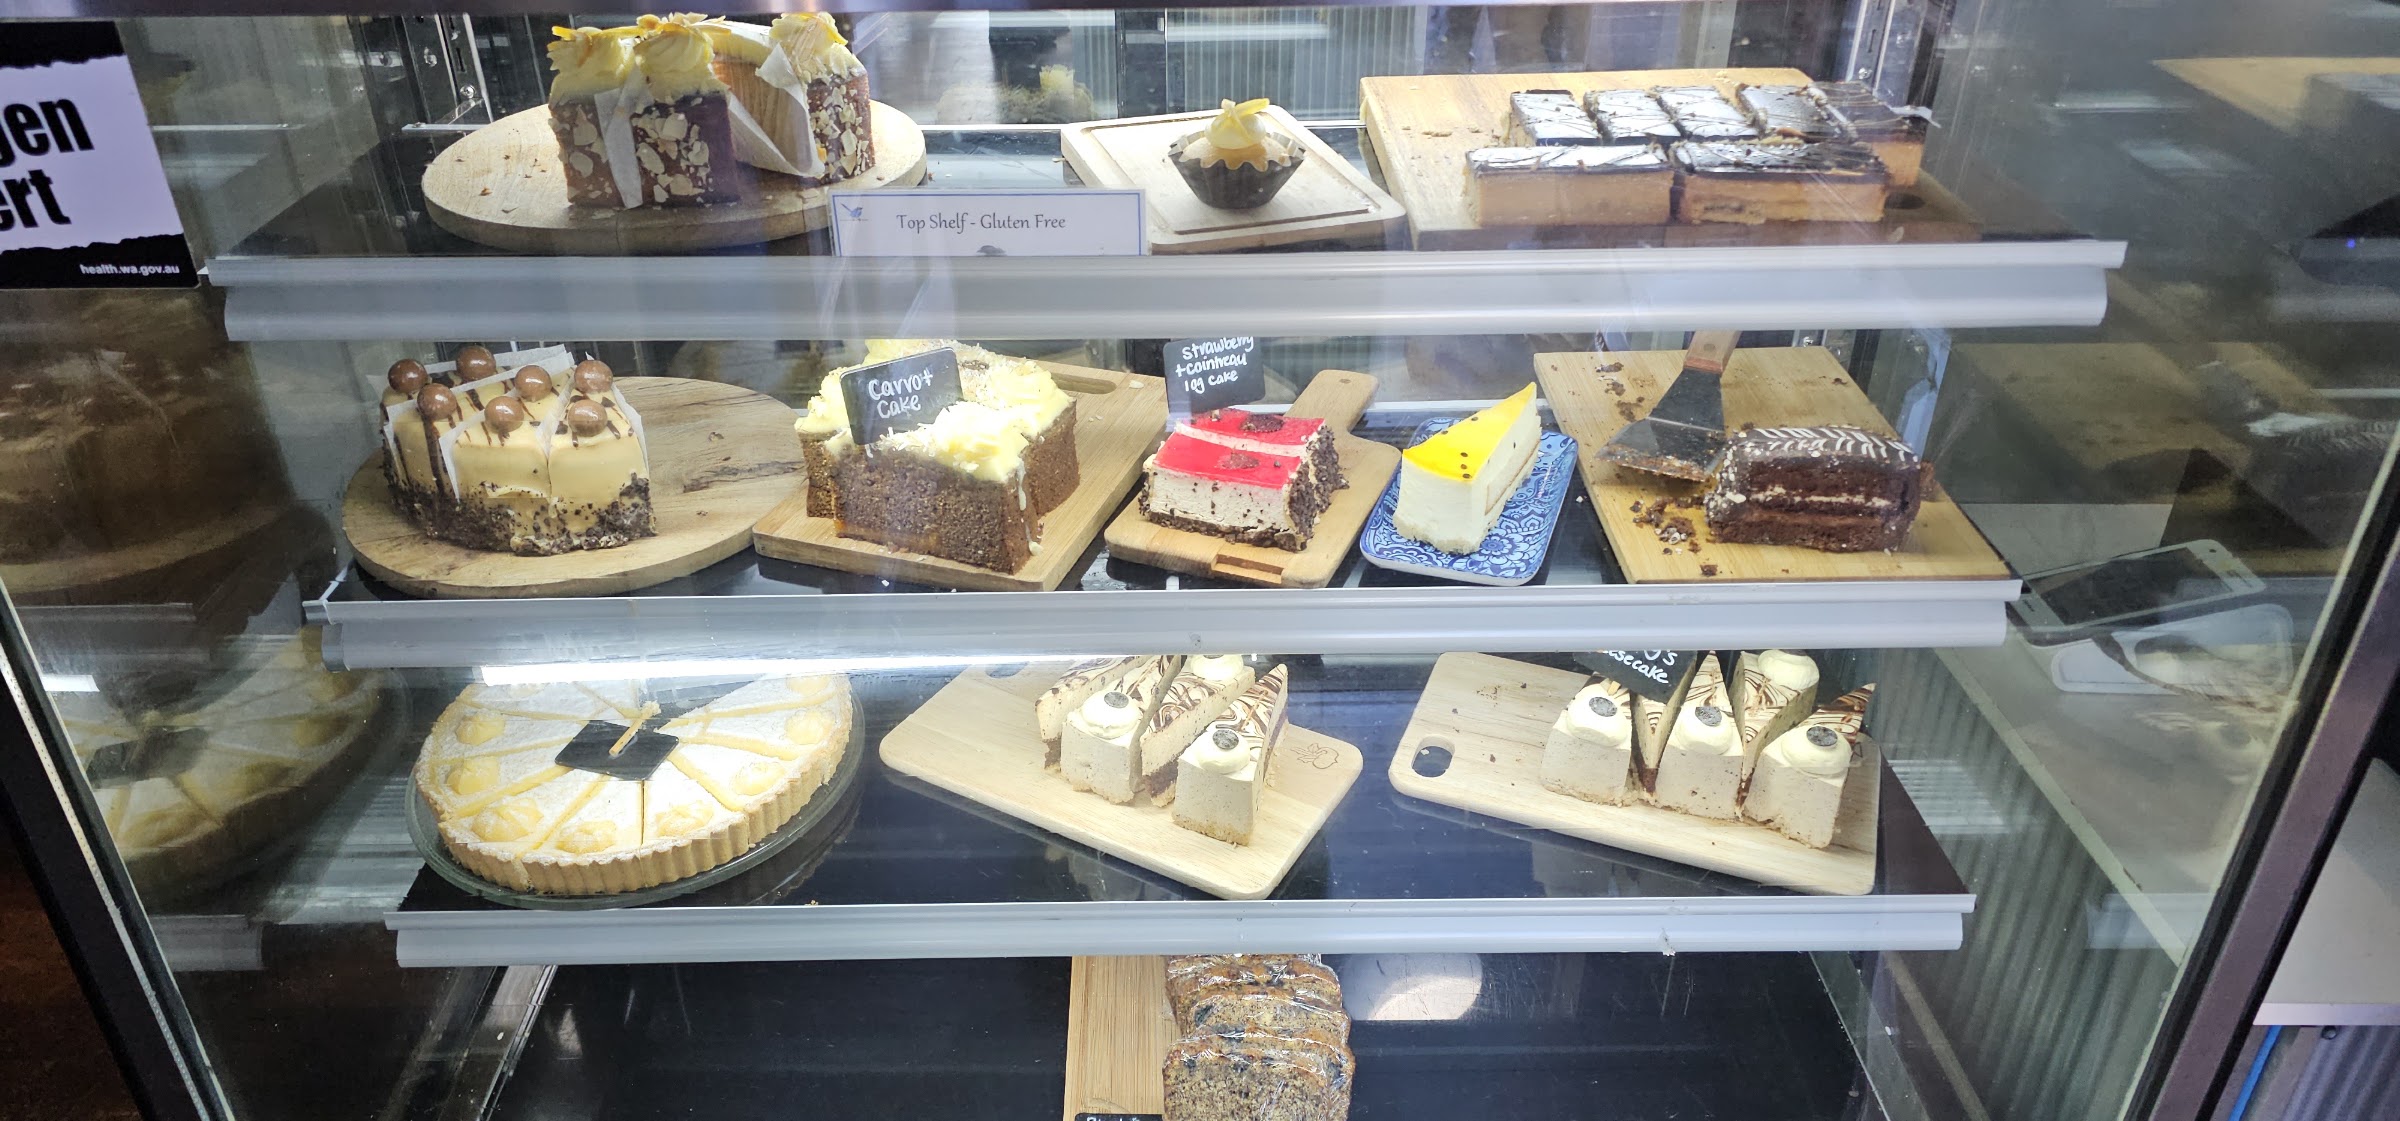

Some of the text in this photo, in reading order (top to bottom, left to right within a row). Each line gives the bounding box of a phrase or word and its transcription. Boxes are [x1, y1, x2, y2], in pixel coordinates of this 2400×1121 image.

[0, 98, 95, 168] en
[896, 213, 926, 234] Top
[929, 212, 968, 234] Shelf
[980, 212, 1030, 229] Gluten
[1034, 213, 1066, 229] Free
[80, 264, 180, 276] health.wa.gov.au
[868, 367, 934, 400] Carrot
